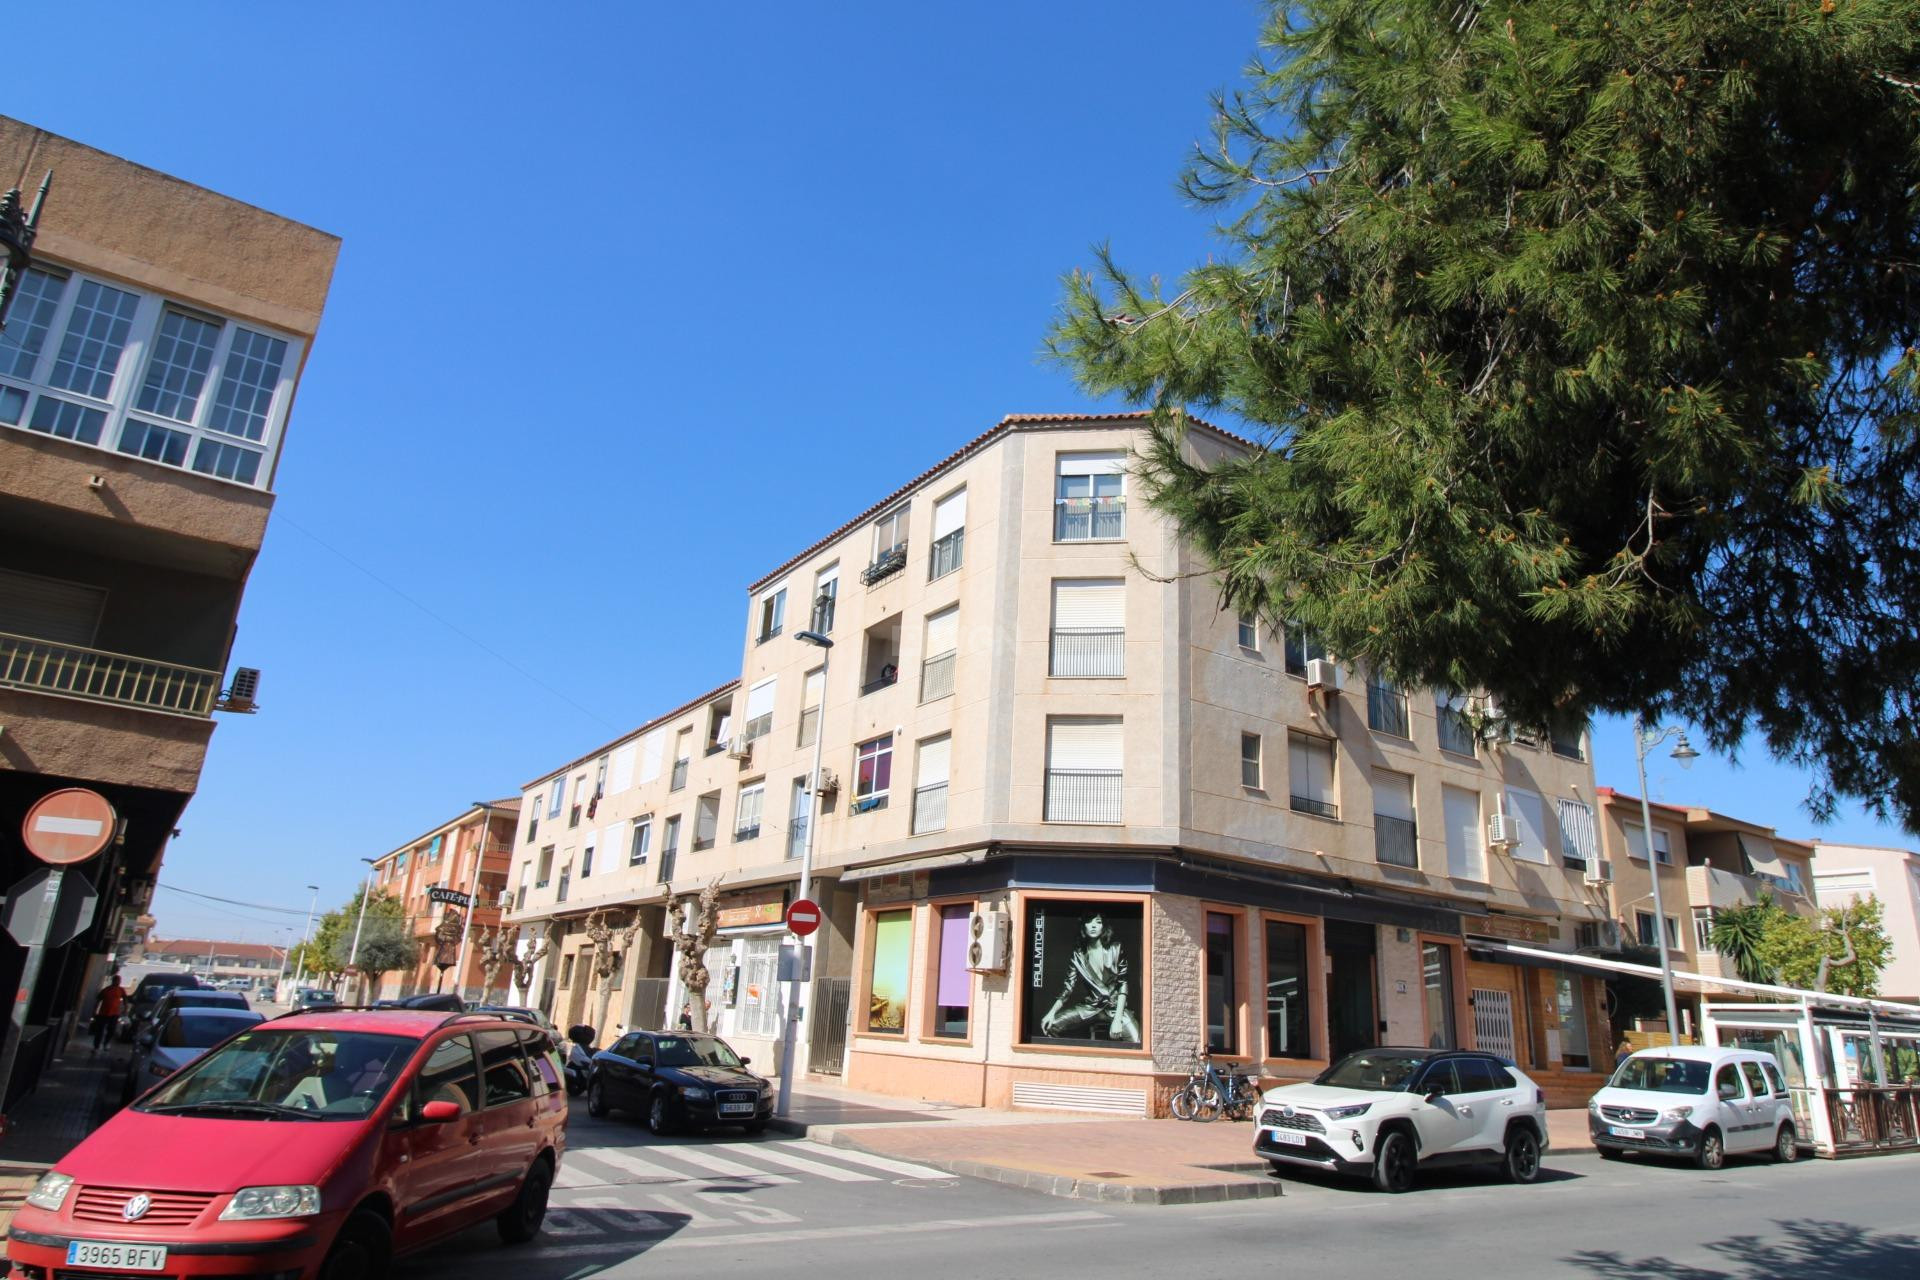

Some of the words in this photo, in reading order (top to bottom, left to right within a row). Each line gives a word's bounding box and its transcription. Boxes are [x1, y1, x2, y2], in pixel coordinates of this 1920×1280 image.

[1033, 959, 1042, 987] PAUL
[79, 1246, 121, 1265] 3965
[126, 1248, 162, 1267] BFV
